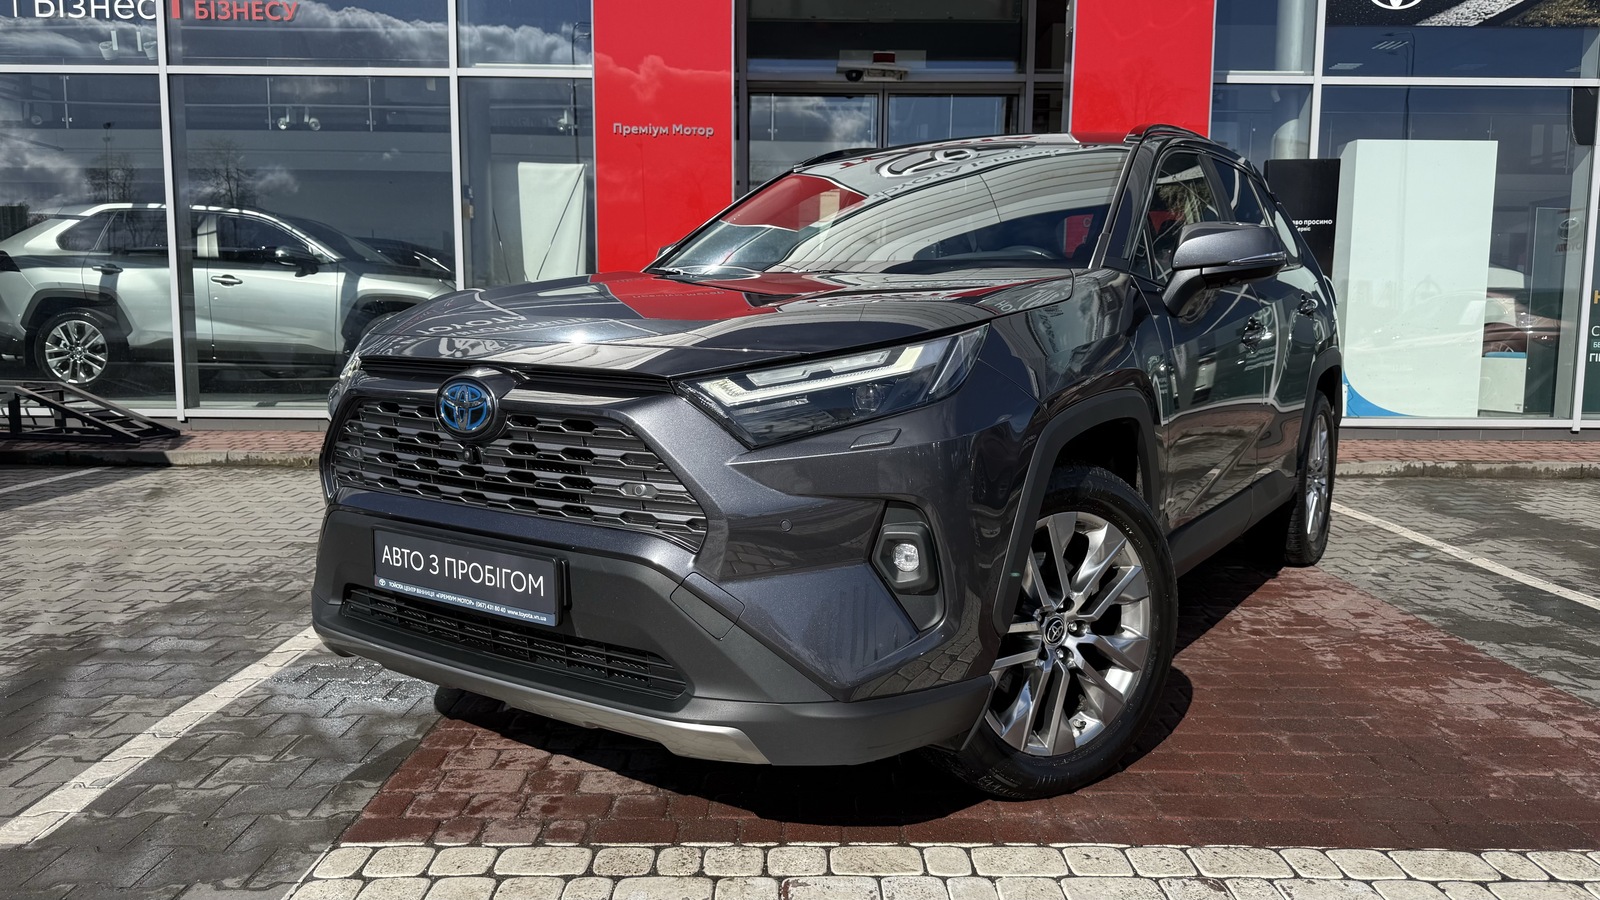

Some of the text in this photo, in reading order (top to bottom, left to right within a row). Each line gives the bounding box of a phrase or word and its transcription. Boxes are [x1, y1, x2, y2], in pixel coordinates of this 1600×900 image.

[194, 0, 297, 21] БІЗНЕСУ
[613, 122, 714, 139] Преміум Мотор
[381, 544, 545, 597] АВТО З ПРОБІГОМ
